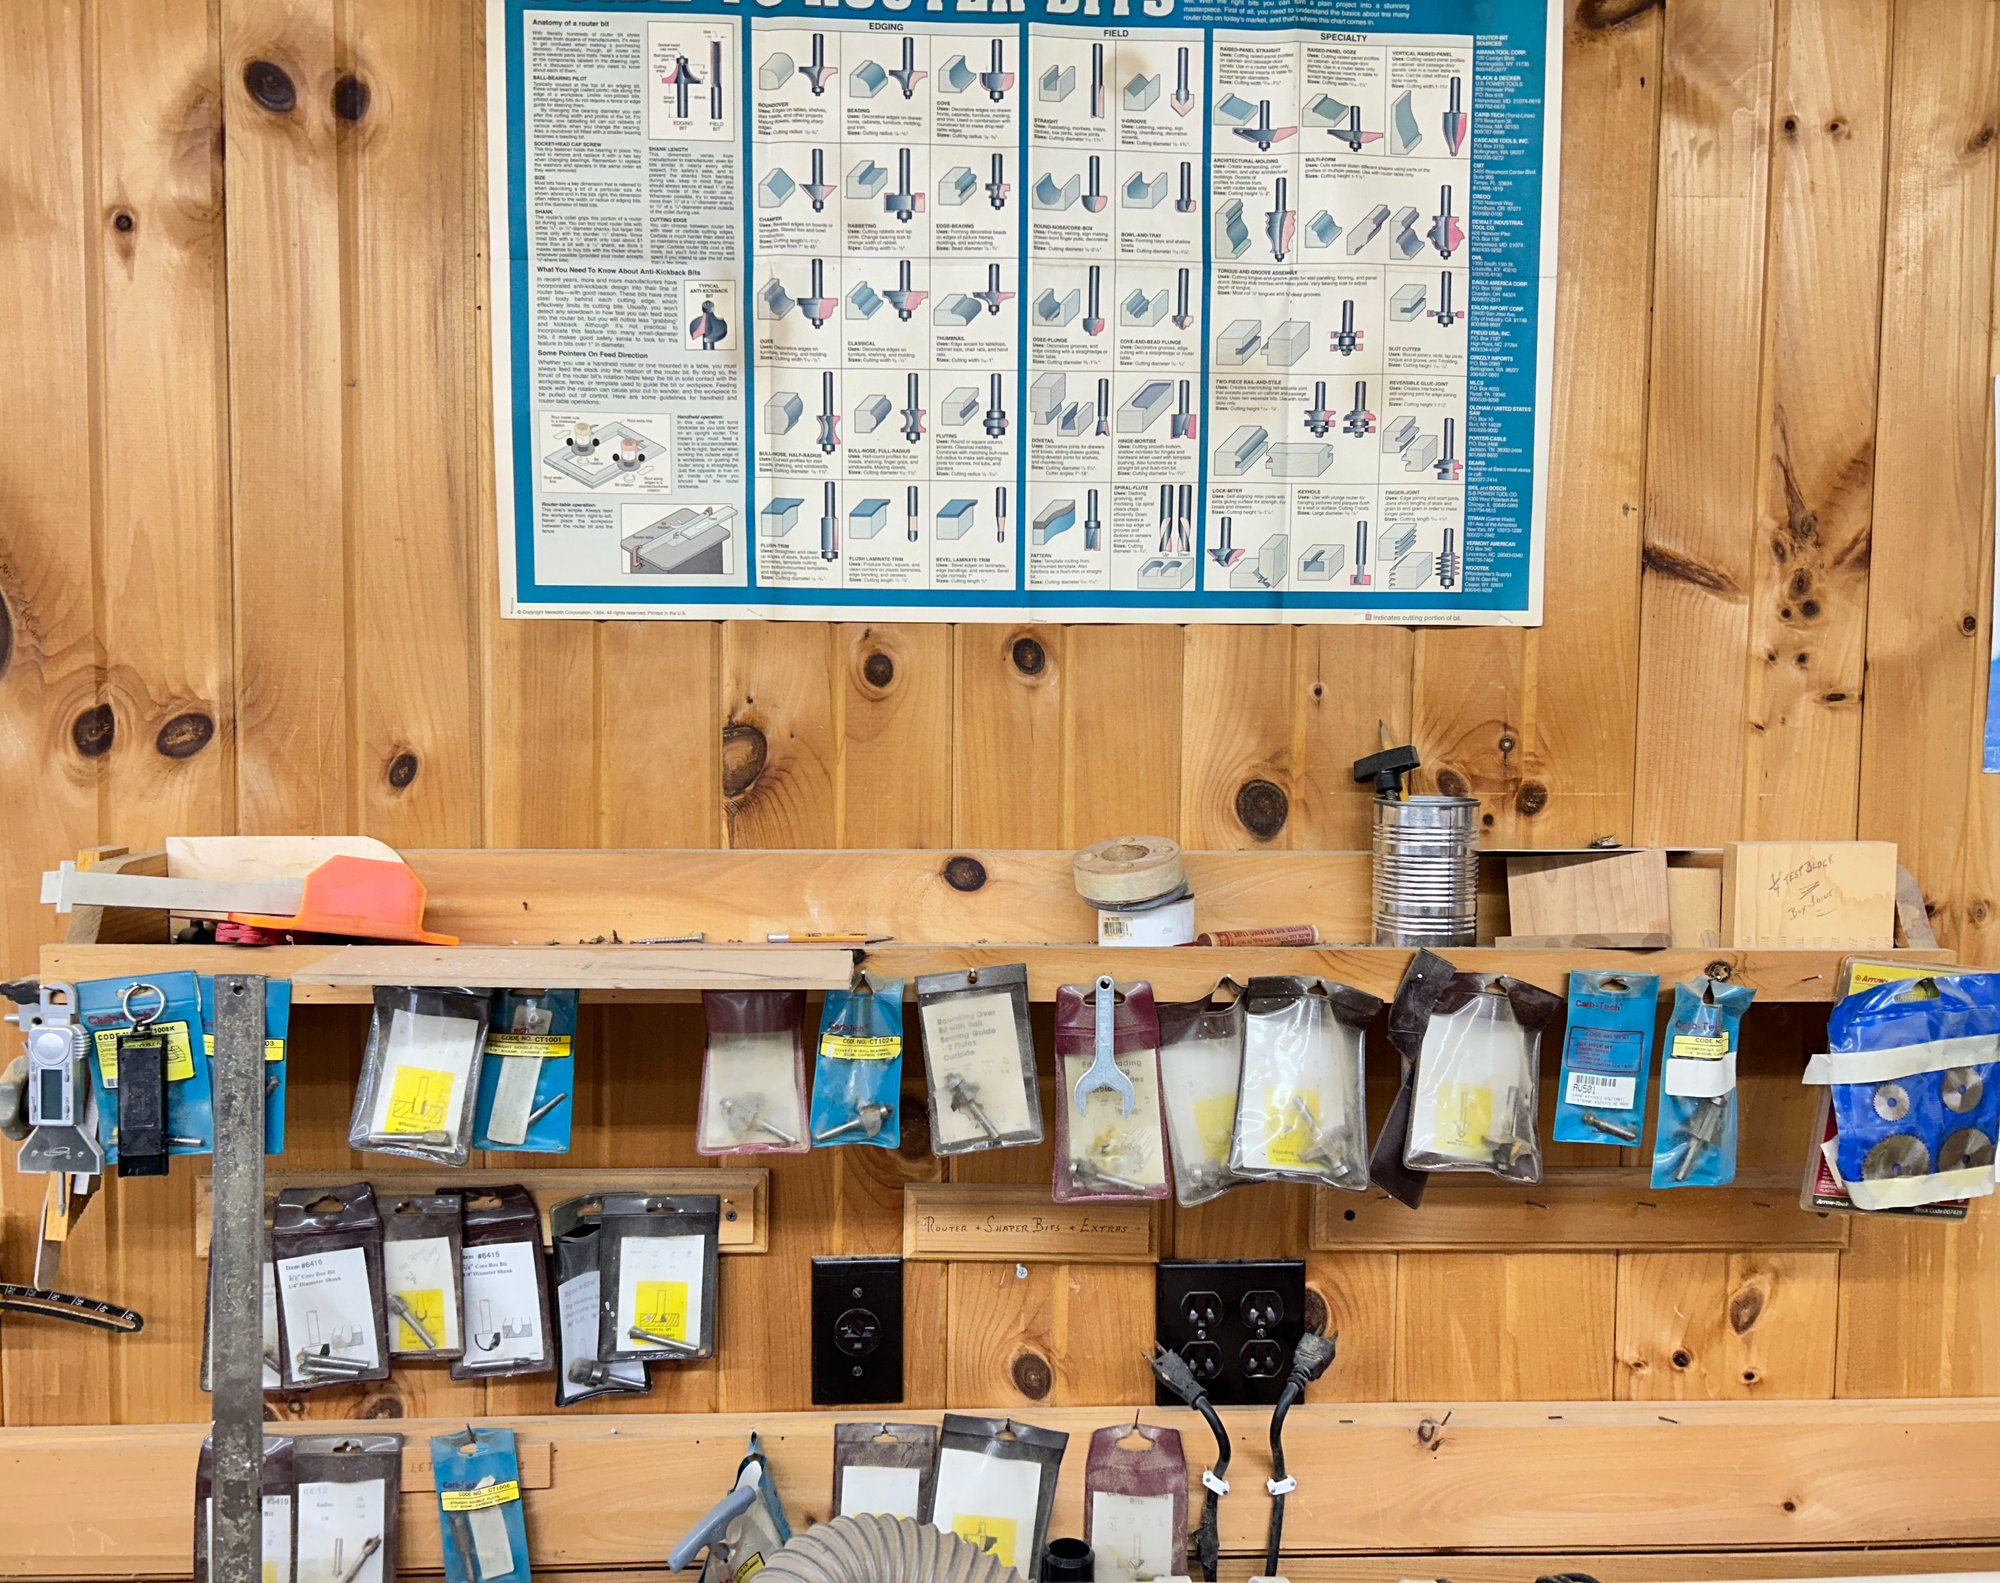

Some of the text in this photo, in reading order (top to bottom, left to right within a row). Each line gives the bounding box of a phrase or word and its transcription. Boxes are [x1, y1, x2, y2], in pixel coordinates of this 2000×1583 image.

[1183, 6, 1222, 15] masterpiece.
[1223, 7, 1237, 15] First
[1238, 8, 1245, 16] of
[1246, 8, 1255, 16] all,
[1256, 8, 1268, 16] you
[1295, 8, 1328, 17] understand
[1329, 9, 1340, 17] the
[1392, 11, 1410, 19] many
[1223, 15, 1244, 23] today's
[1245, 15, 1268, 23] market,
[1269, 15, 1281, 23] and
[1299, 16, 1317, 24] where
[1318, 16, 1329, 24] this
[1330, 17, 1345, 25] chart
[1346, 18, 1366, 26] comes
[869, 22, 904, 31] EDGING
[1104, 29, 1129, 38] FIELD
[1320, 33, 1367, 42] SPECIALTY
[1373, 614, 1461, 622] Indicates cutting portion of bit.
[1783, 865, 1803, 885] TEST
[1804, 853, 1834, 873] BLOCK
[976, 1010, 996, 1018] Over
[950, 1023, 966, 1031] with
[972, 1027, 996, 1037] Guide
[924, 1215, 1128, 1233] ROUTER SHAPER BITS EXTRAS
[477, 1251, 500, 1259] #6415
